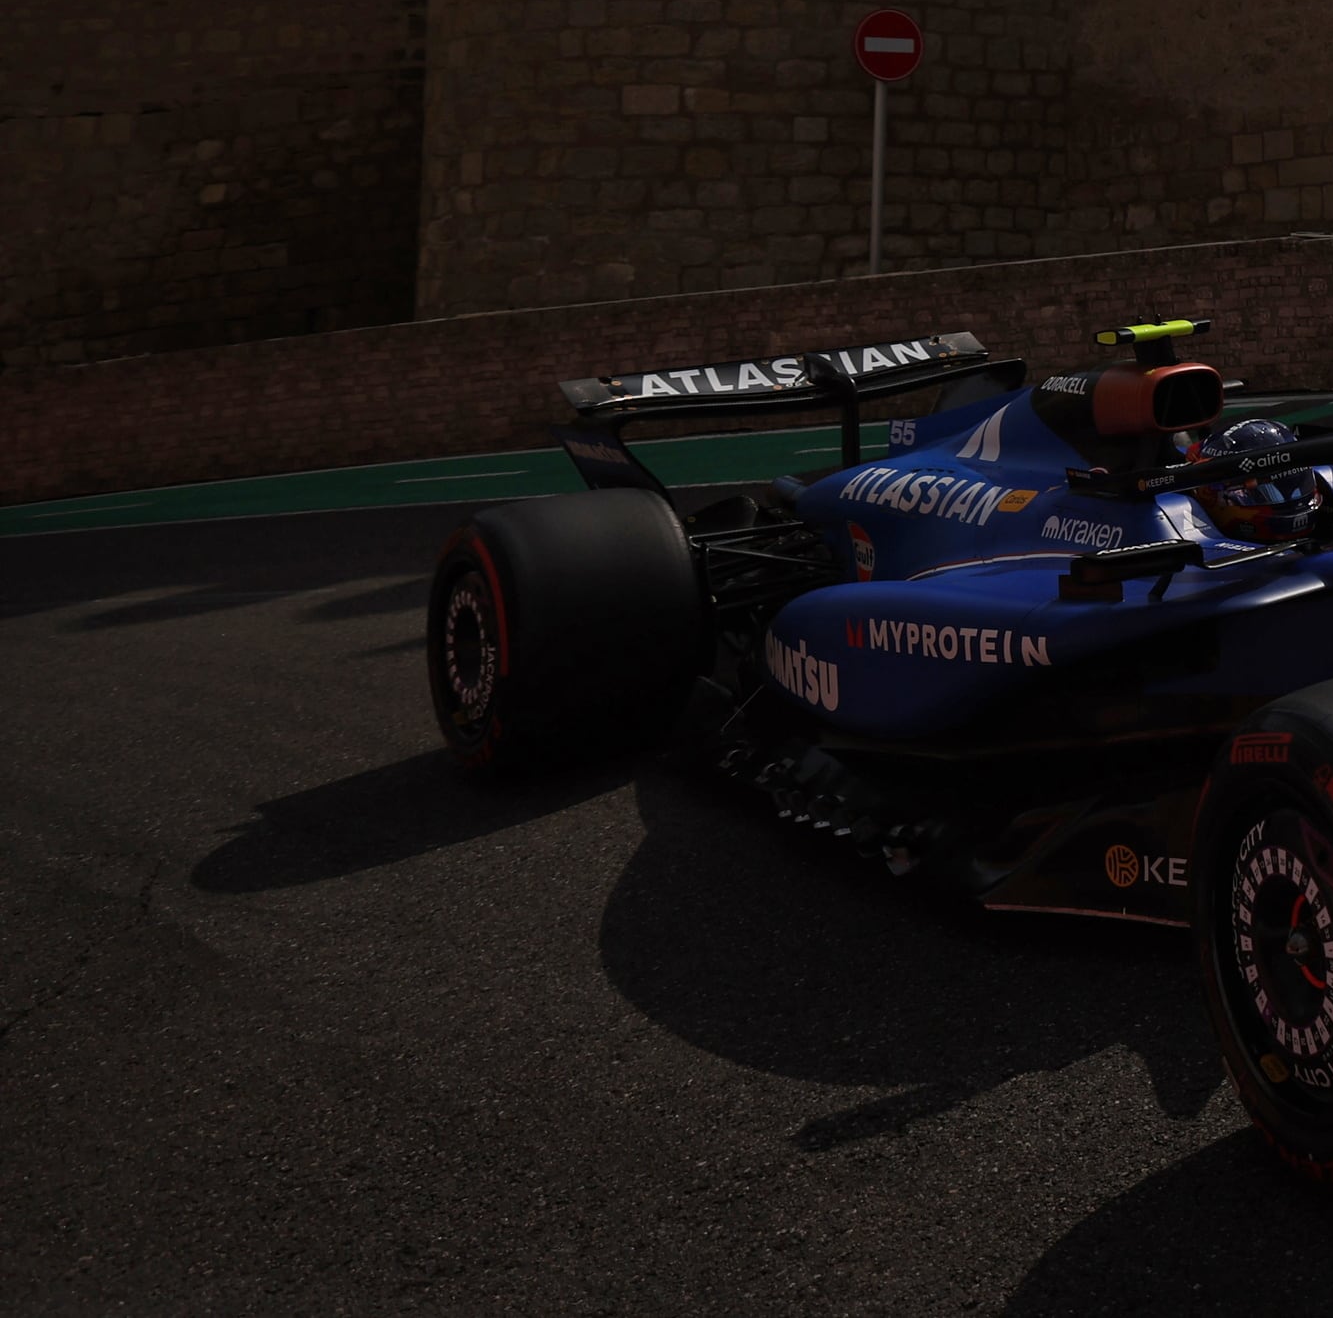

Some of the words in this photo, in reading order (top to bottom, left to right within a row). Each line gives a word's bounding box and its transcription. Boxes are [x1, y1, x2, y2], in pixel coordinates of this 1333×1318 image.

[641, 340, 931, 398] ATLASIAN
[1040, 375, 1088, 396] DURACELL
[890, 419, 917, 446] 55
[1256, 451, 1291, 468] airia
[839, 467, 1014, 527] ATLASSIAN
[1145, 475, 1175, 488] KEEPER
[1059, 516, 1124, 549] kraken
[868, 617, 1053, 667] MYPROTEIN
[765, 625, 840, 713] OMATSU
[1228, 731, 1294, 766] PIRELLI
